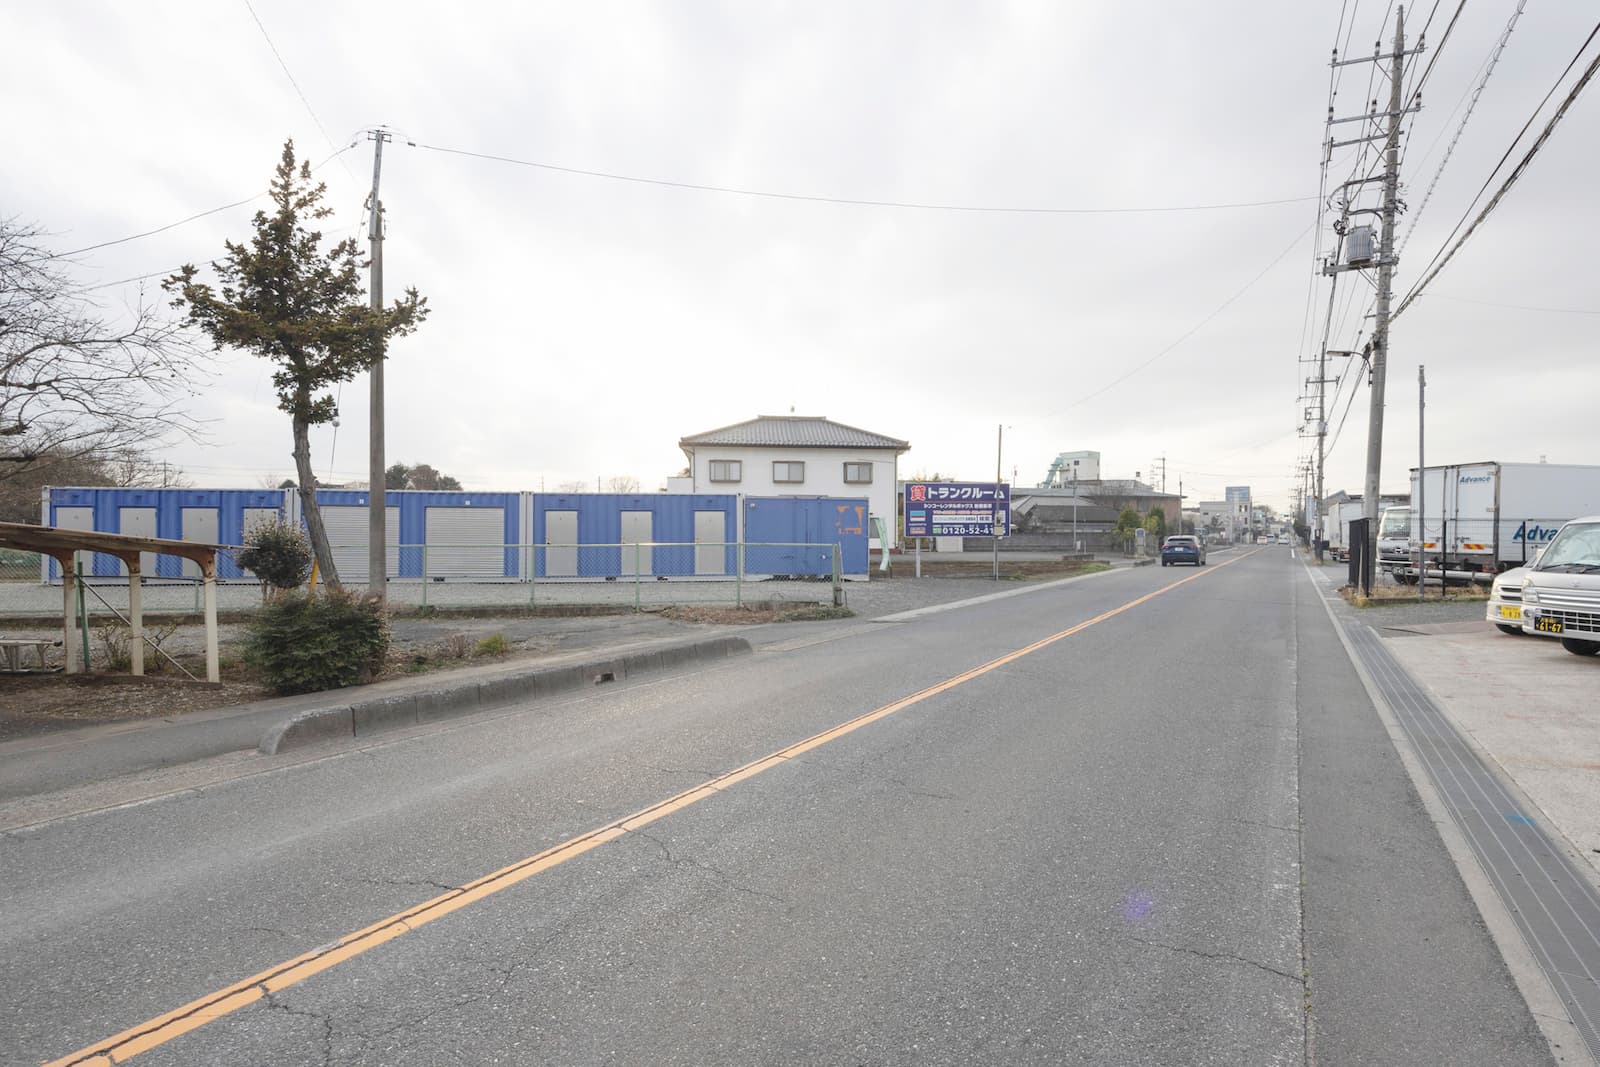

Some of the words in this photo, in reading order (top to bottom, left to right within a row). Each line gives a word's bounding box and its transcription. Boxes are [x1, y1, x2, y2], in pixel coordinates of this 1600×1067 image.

[1460, 476, 1491, 484] Advance
[927, 487, 1005, 499] トランクルーム
